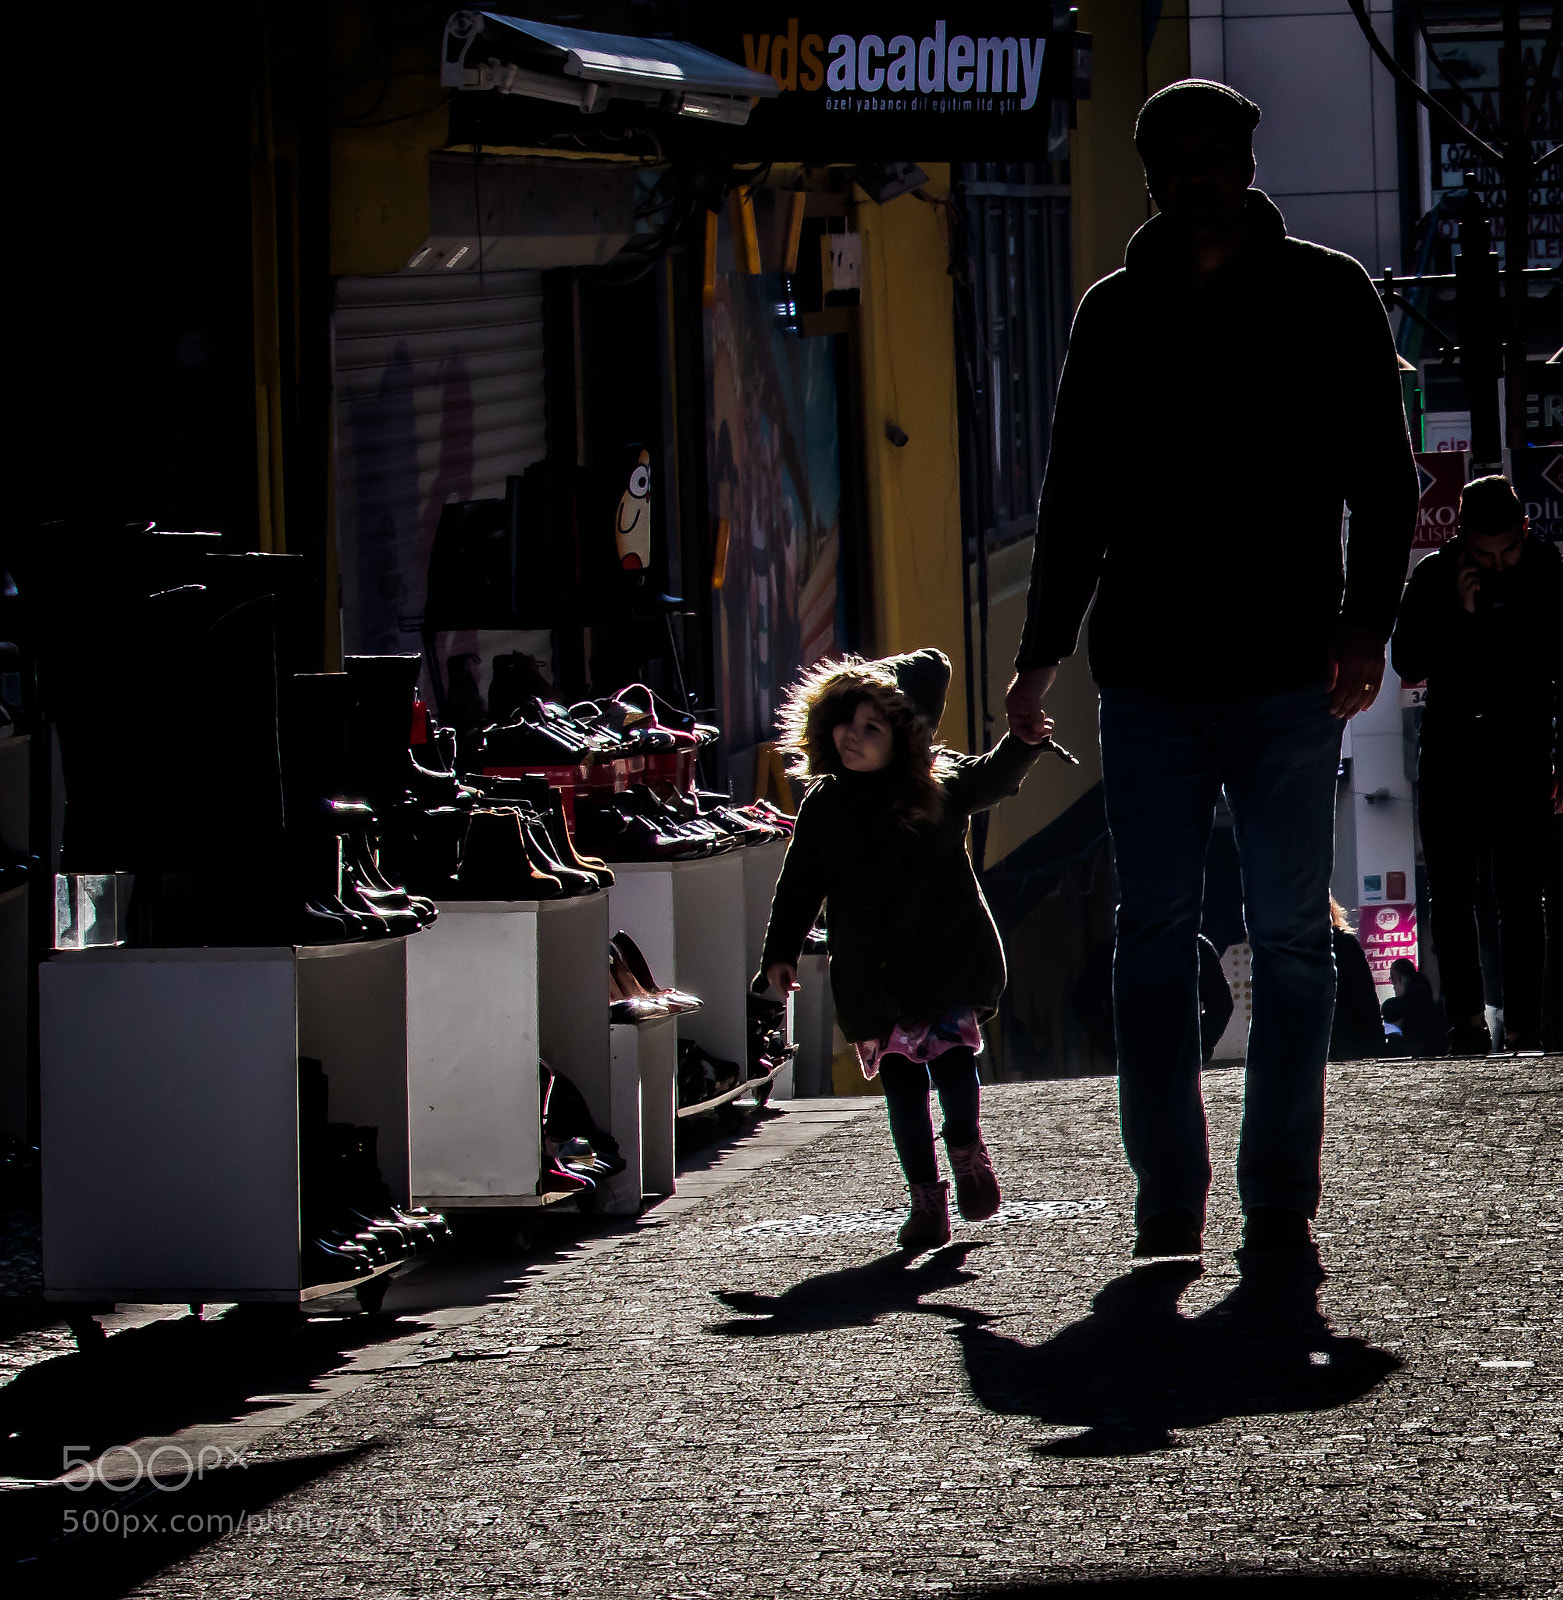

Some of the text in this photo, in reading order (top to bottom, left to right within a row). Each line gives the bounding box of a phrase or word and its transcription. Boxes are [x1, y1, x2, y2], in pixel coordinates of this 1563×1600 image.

[826, 97, 852, 110] özel
[856, 97, 907, 113] yabancı
[911, 97, 928, 110] dil
[932, 97, 972, 113] eğitim
